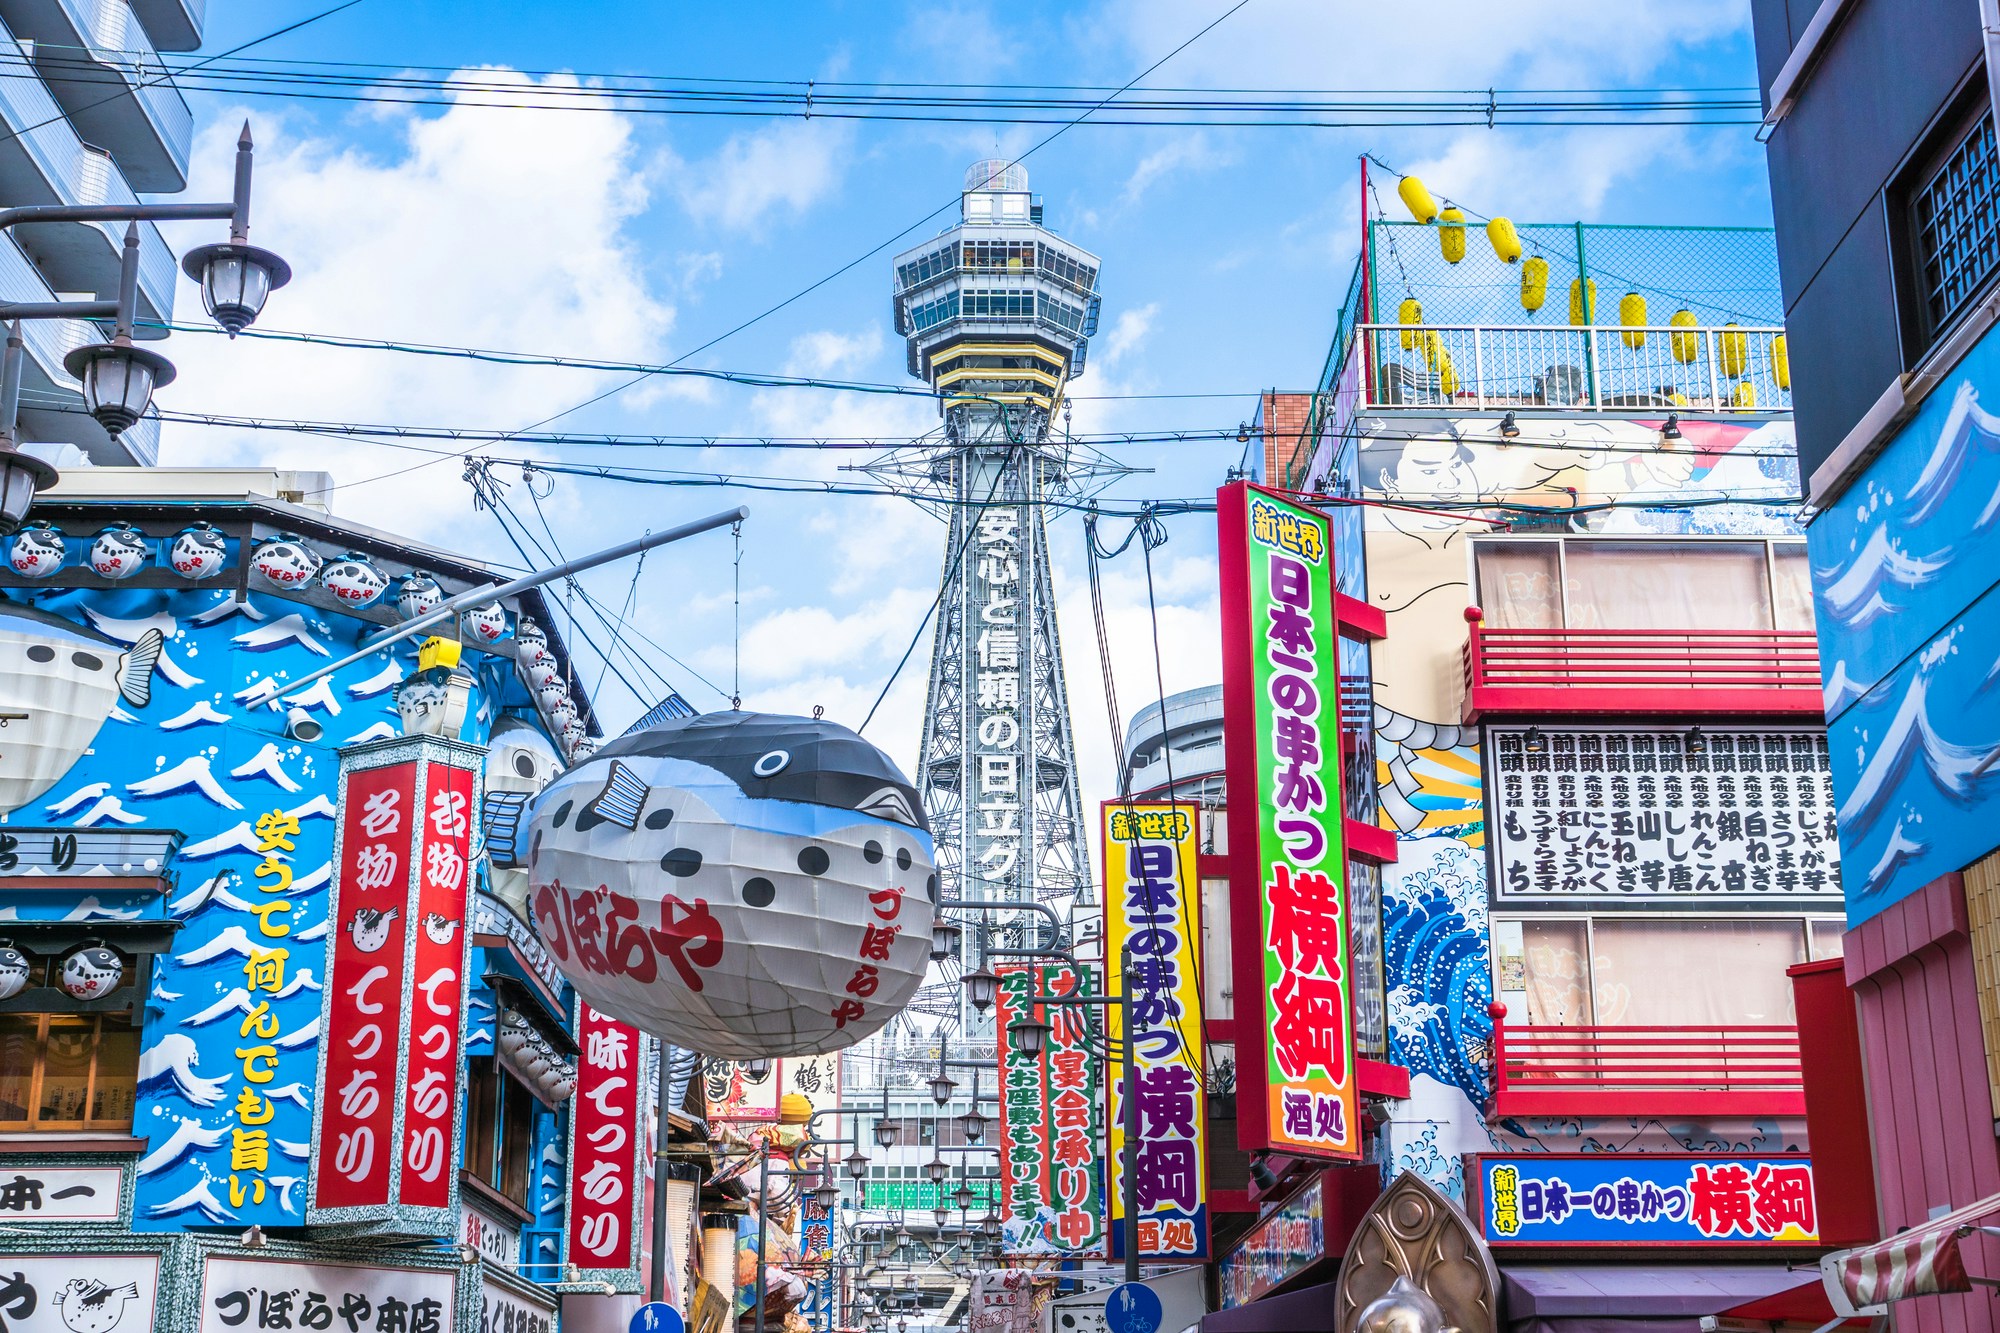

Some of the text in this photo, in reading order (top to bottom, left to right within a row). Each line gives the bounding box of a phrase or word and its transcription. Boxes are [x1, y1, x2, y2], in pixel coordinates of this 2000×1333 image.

[1252, 501, 1323, 563] 新世界
[1499, 734, 1525, 772] 前頭
[1552, 734, 1577, 772] 前頭
[1579, 734, 1604, 773] 前頭
[1605, 734, 1630, 773] 前頭
[1631, 734, 1657, 773] 前頭
[1658, 734, 1684, 773] 前頭
[1710, 734, 1737, 773] 前頭
[1737, 734, 1763, 773] 前頭
[1763, 734, 1789, 773] 前頭
[1789, 734, 1816, 773] 前頭
[1112, 811, 1189, 841] 新世界
[1269, 554, 1344, 1086] 日本一の串かつ 横綱
[1504, 810, 1530, 891] もち
[1531, 810, 1560, 891] うずら玉子
[1556, 810, 1587, 891] 紅しょうが
[1583, 811, 1611, 891] にんにく
[1611, 811, 1640, 891] 玉ねぎ
[1637, 811, 1665, 891] 山芋
[1665, 811, 1693, 891] しし唐
[1690, 811, 1720, 891] れんこん
[1716, 811, 1747, 891] 銀杏
[1745, 811, 1773, 891] 白ねぎ
[1771, 811, 1800, 891] さつま芋
[1798, 811, 1827, 891] じゃが芋
[535, 879, 724, 992] づぼらや
[831, 886, 905, 1029] づぼらや
[228, 810, 300, 1208] 安うて何んでも旨い
[335, 789, 401, 1182] 名物 てっちり
[408, 789, 466, 1183] 名物 てっちり
[1117, 845, 1198, 1212] 日本一の串かつ 横綱
[1051, 969, 1091, 1247] 大小宴会承り中
[1284, 1089, 1345, 1141] 酒処
[1493, 1166, 1518, 1234] 新世界
[1521, 1165, 1815, 1235] 日本一の串かつ 横綱
[481, 1224, 507, 1261] てっちり
[215, 1286, 443, 1333] づぼらや本店
